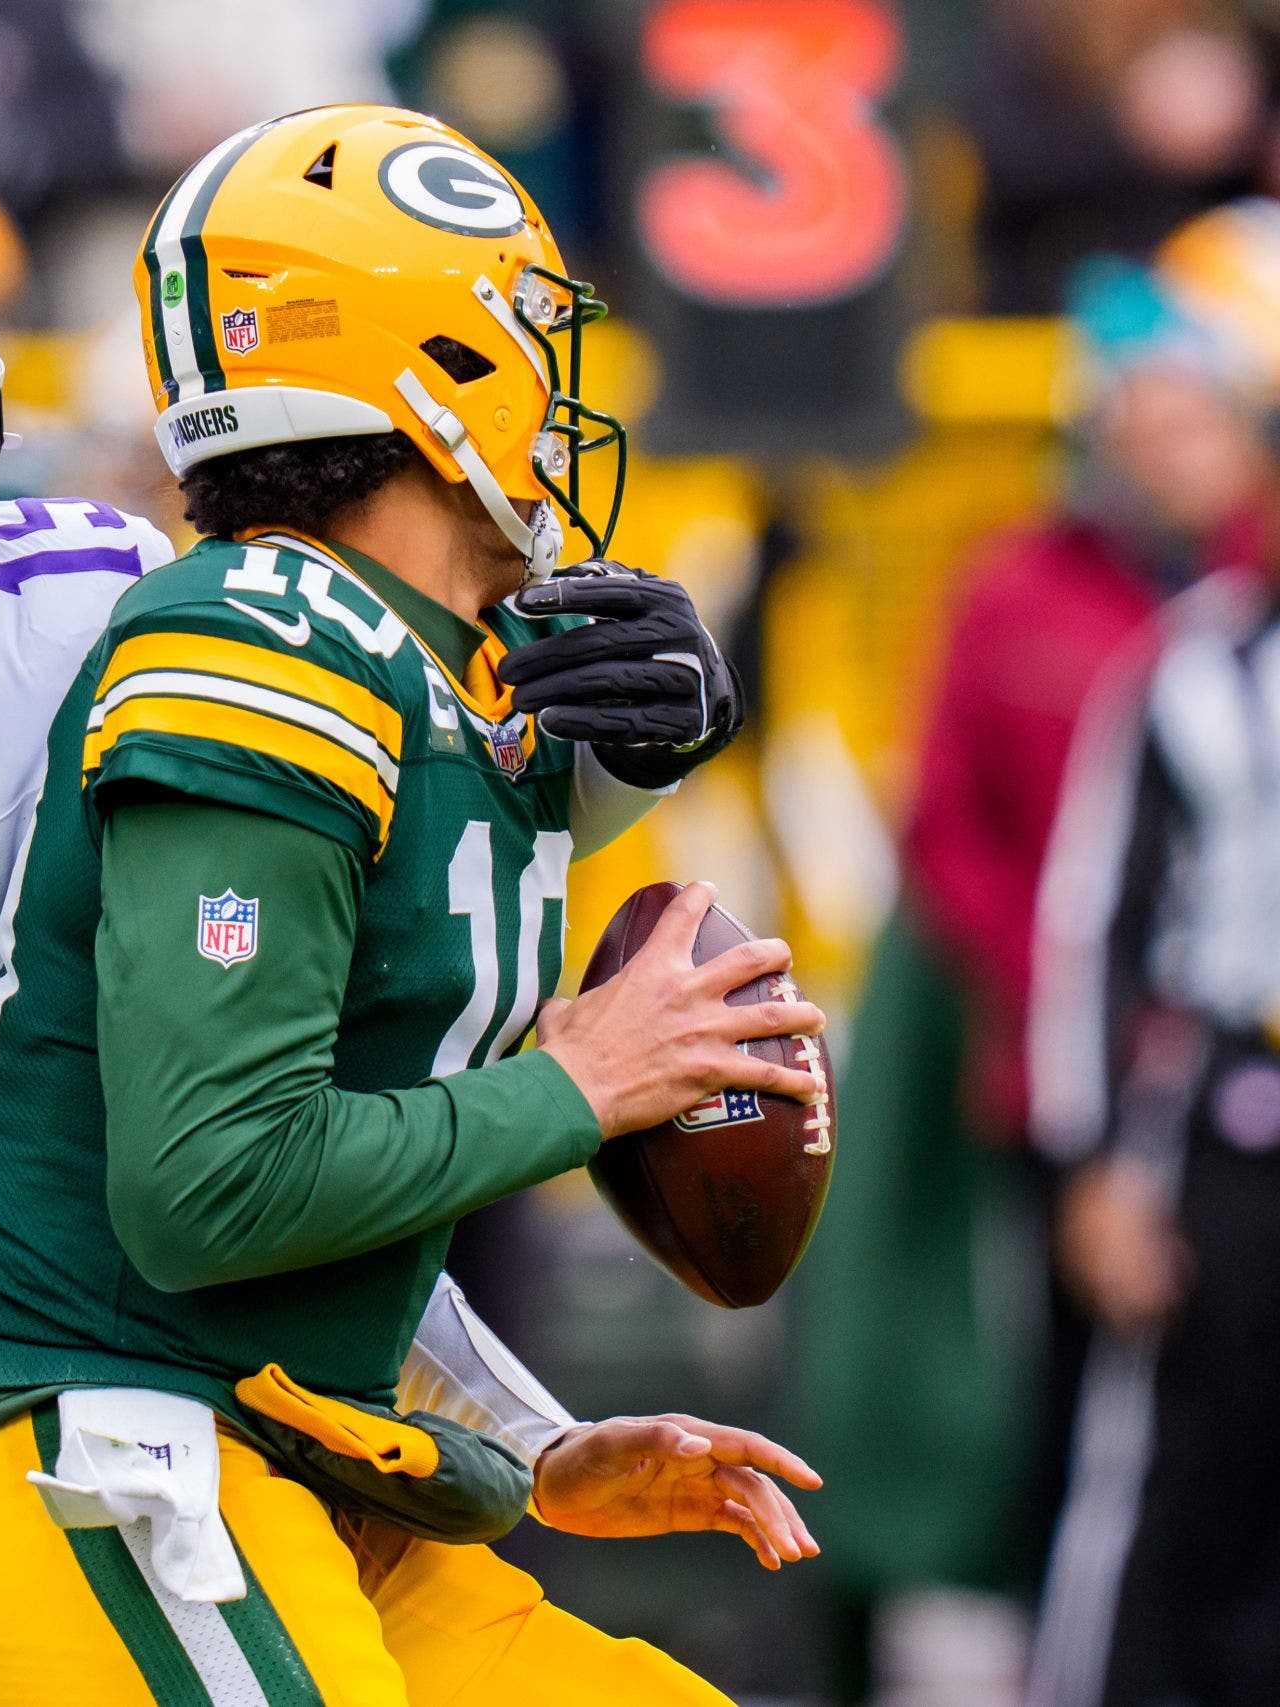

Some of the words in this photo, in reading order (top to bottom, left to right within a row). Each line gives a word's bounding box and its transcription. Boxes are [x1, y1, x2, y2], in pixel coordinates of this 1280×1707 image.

[641, 0, 910, 308] 3
[387, 145, 523, 230] G
[226, 327, 255, 349] NFL
[168, 405, 239, 449] PACKERS
[498, 745, 524, 770] NFL
[205, 923, 250, 956] NFL
